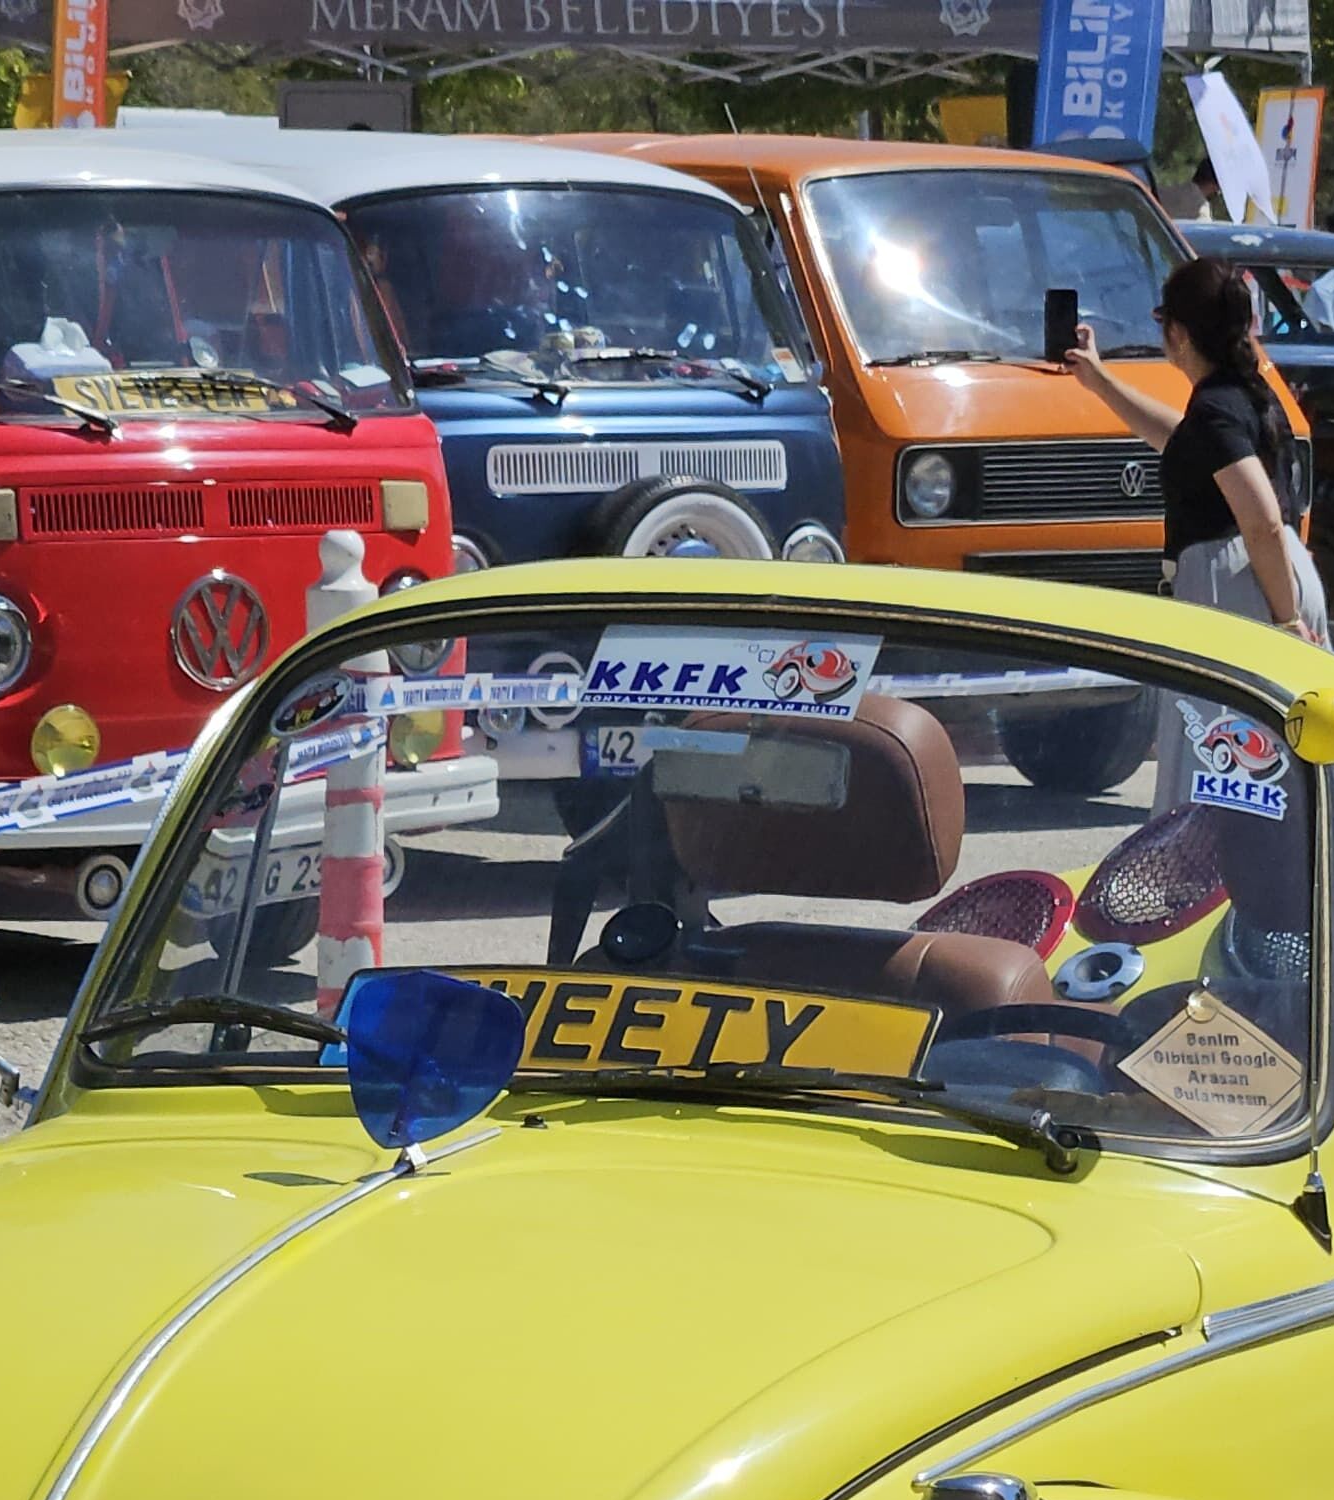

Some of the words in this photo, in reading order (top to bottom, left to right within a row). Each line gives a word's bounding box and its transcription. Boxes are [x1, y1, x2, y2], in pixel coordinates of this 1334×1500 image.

[171, 569, 270, 691] VW
[588, 661, 747, 696] KKFK
[600, 730, 635, 765] 42
[1197, 775, 1282, 807] KKFK
[1186, 1032, 1239, 1047] Benim
[1220, 1051, 1277, 1068] Google
[1187, 1070, 1249, 1086] Arasan
